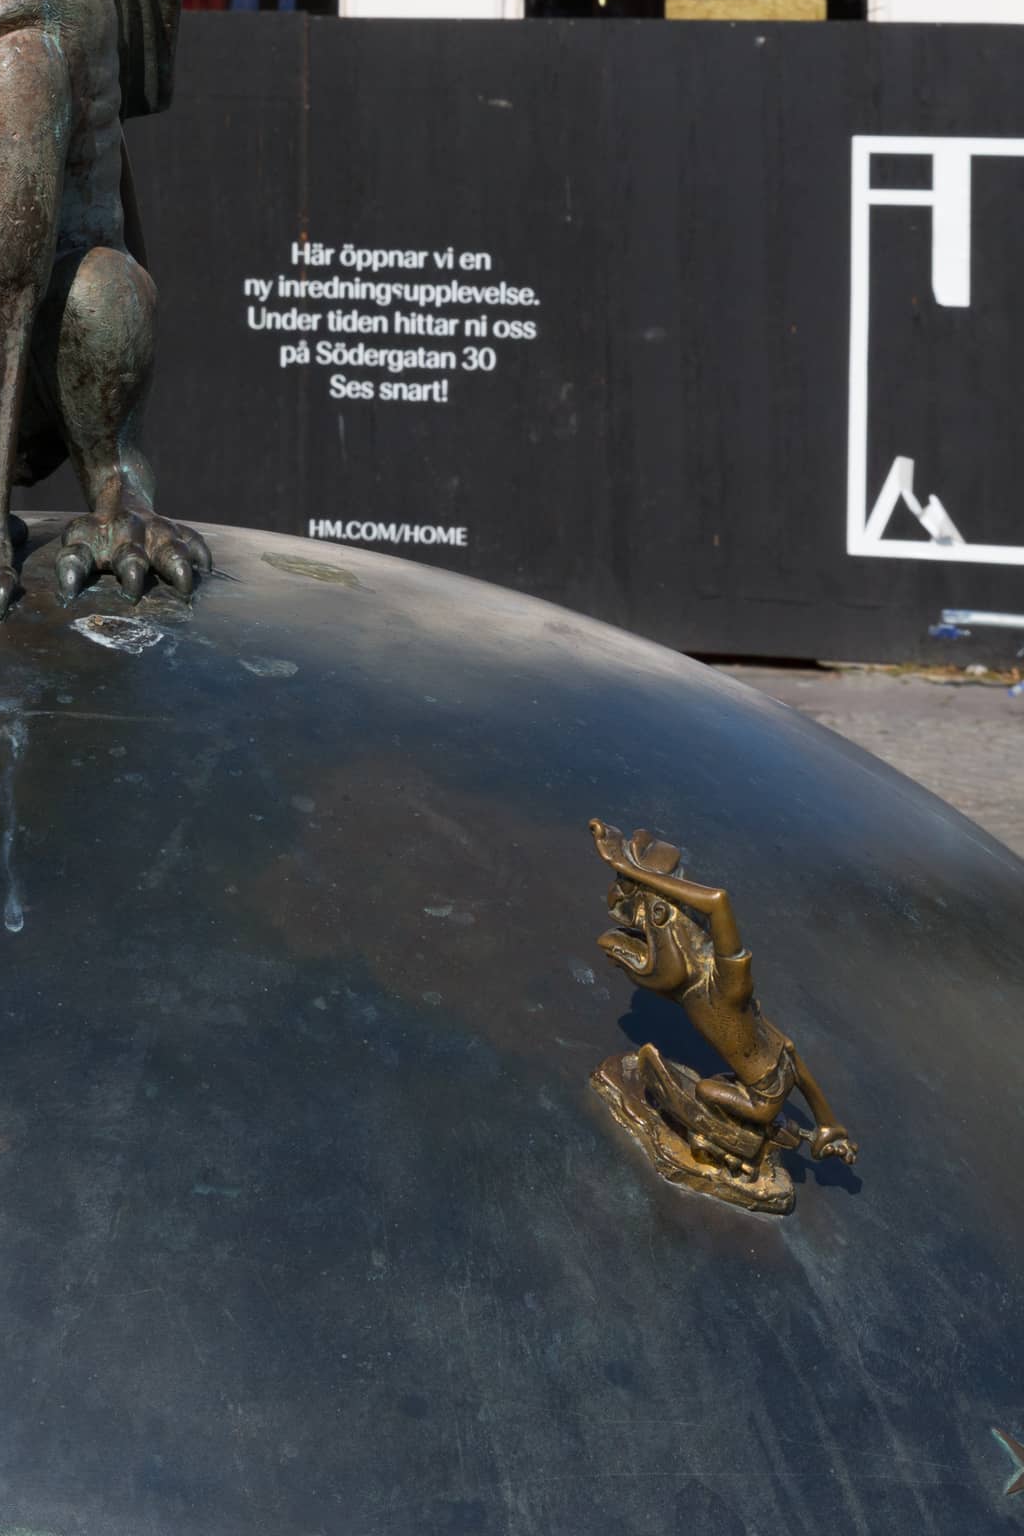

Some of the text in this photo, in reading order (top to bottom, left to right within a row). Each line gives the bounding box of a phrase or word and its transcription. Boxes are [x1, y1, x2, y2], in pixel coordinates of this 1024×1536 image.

[291, 242, 492, 272] Här öppnar vi en
[244, 275, 541, 307] ny inredningsupplevelse.
[247, 306, 538, 340] Under tiden hittar ni oss
[279, 340, 497, 373] på Södergatan 30
[329, 374, 449, 403] Ses snart!
[308, 519, 469, 547] HM.COM/HOME
